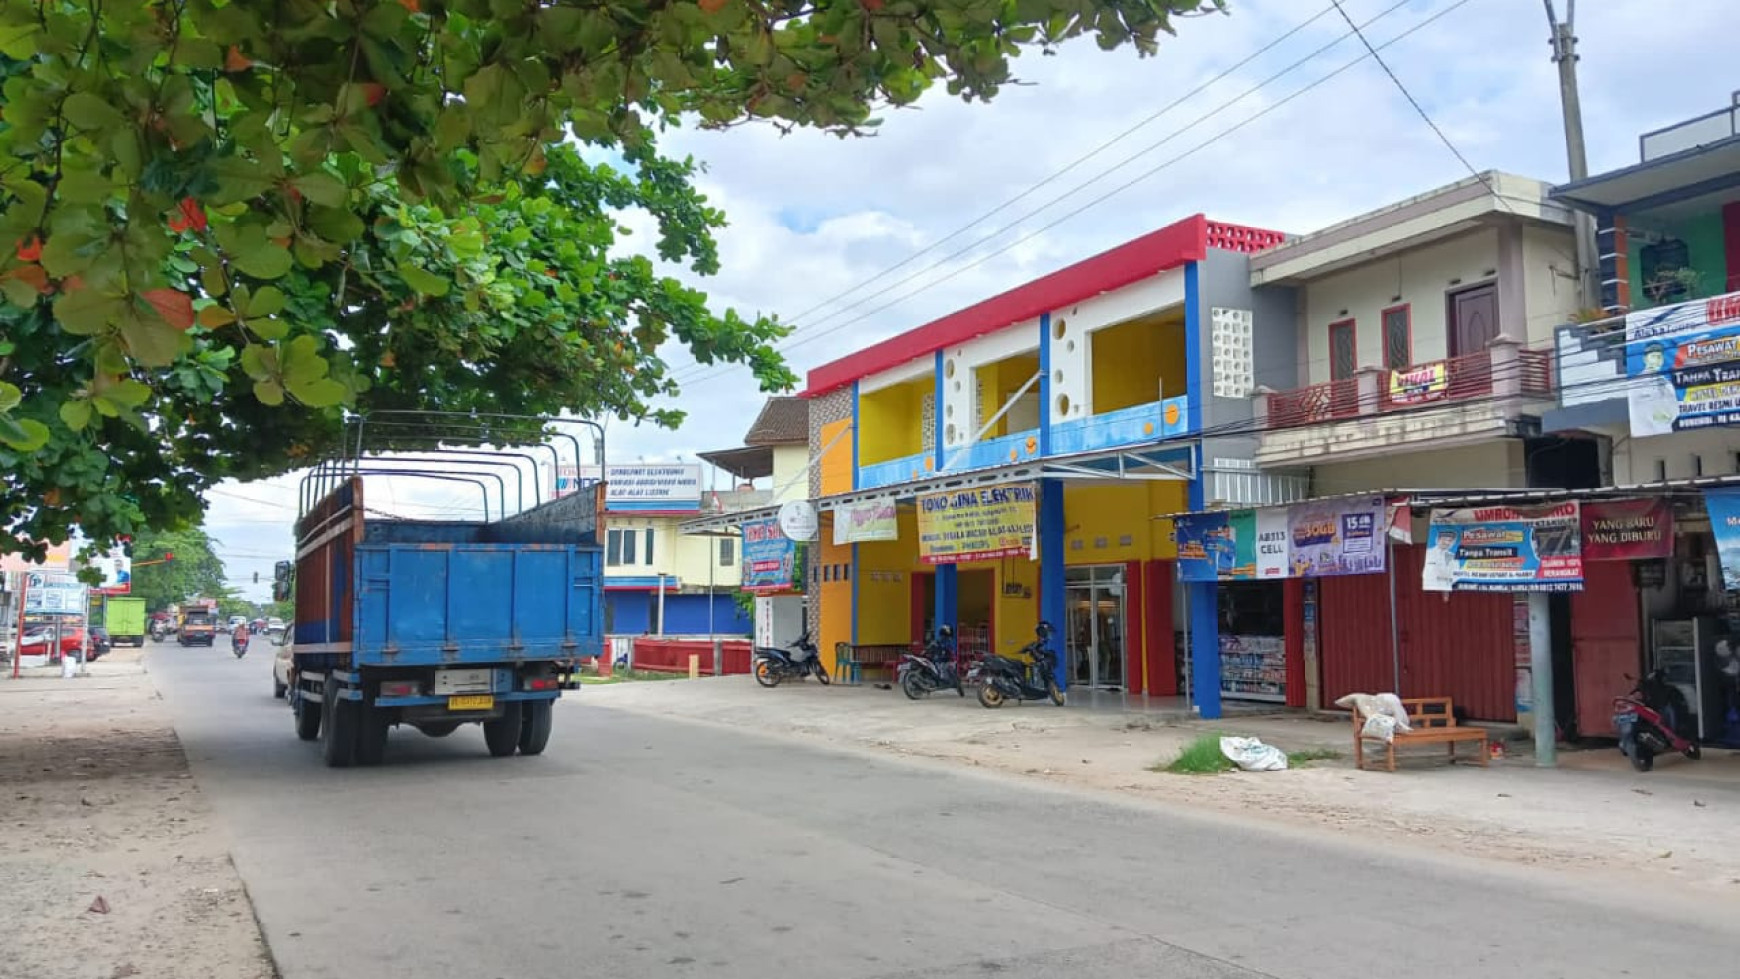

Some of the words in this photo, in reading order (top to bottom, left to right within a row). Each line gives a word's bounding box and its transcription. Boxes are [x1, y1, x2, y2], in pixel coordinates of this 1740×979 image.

[921, 496, 948, 513] TOKO
[1593, 520, 1623, 530] YANG
[1587, 532, 1618, 544] YANG
[1620, 530, 1661, 543] DIBURU
[1260, 544, 1284, 555] CELL
